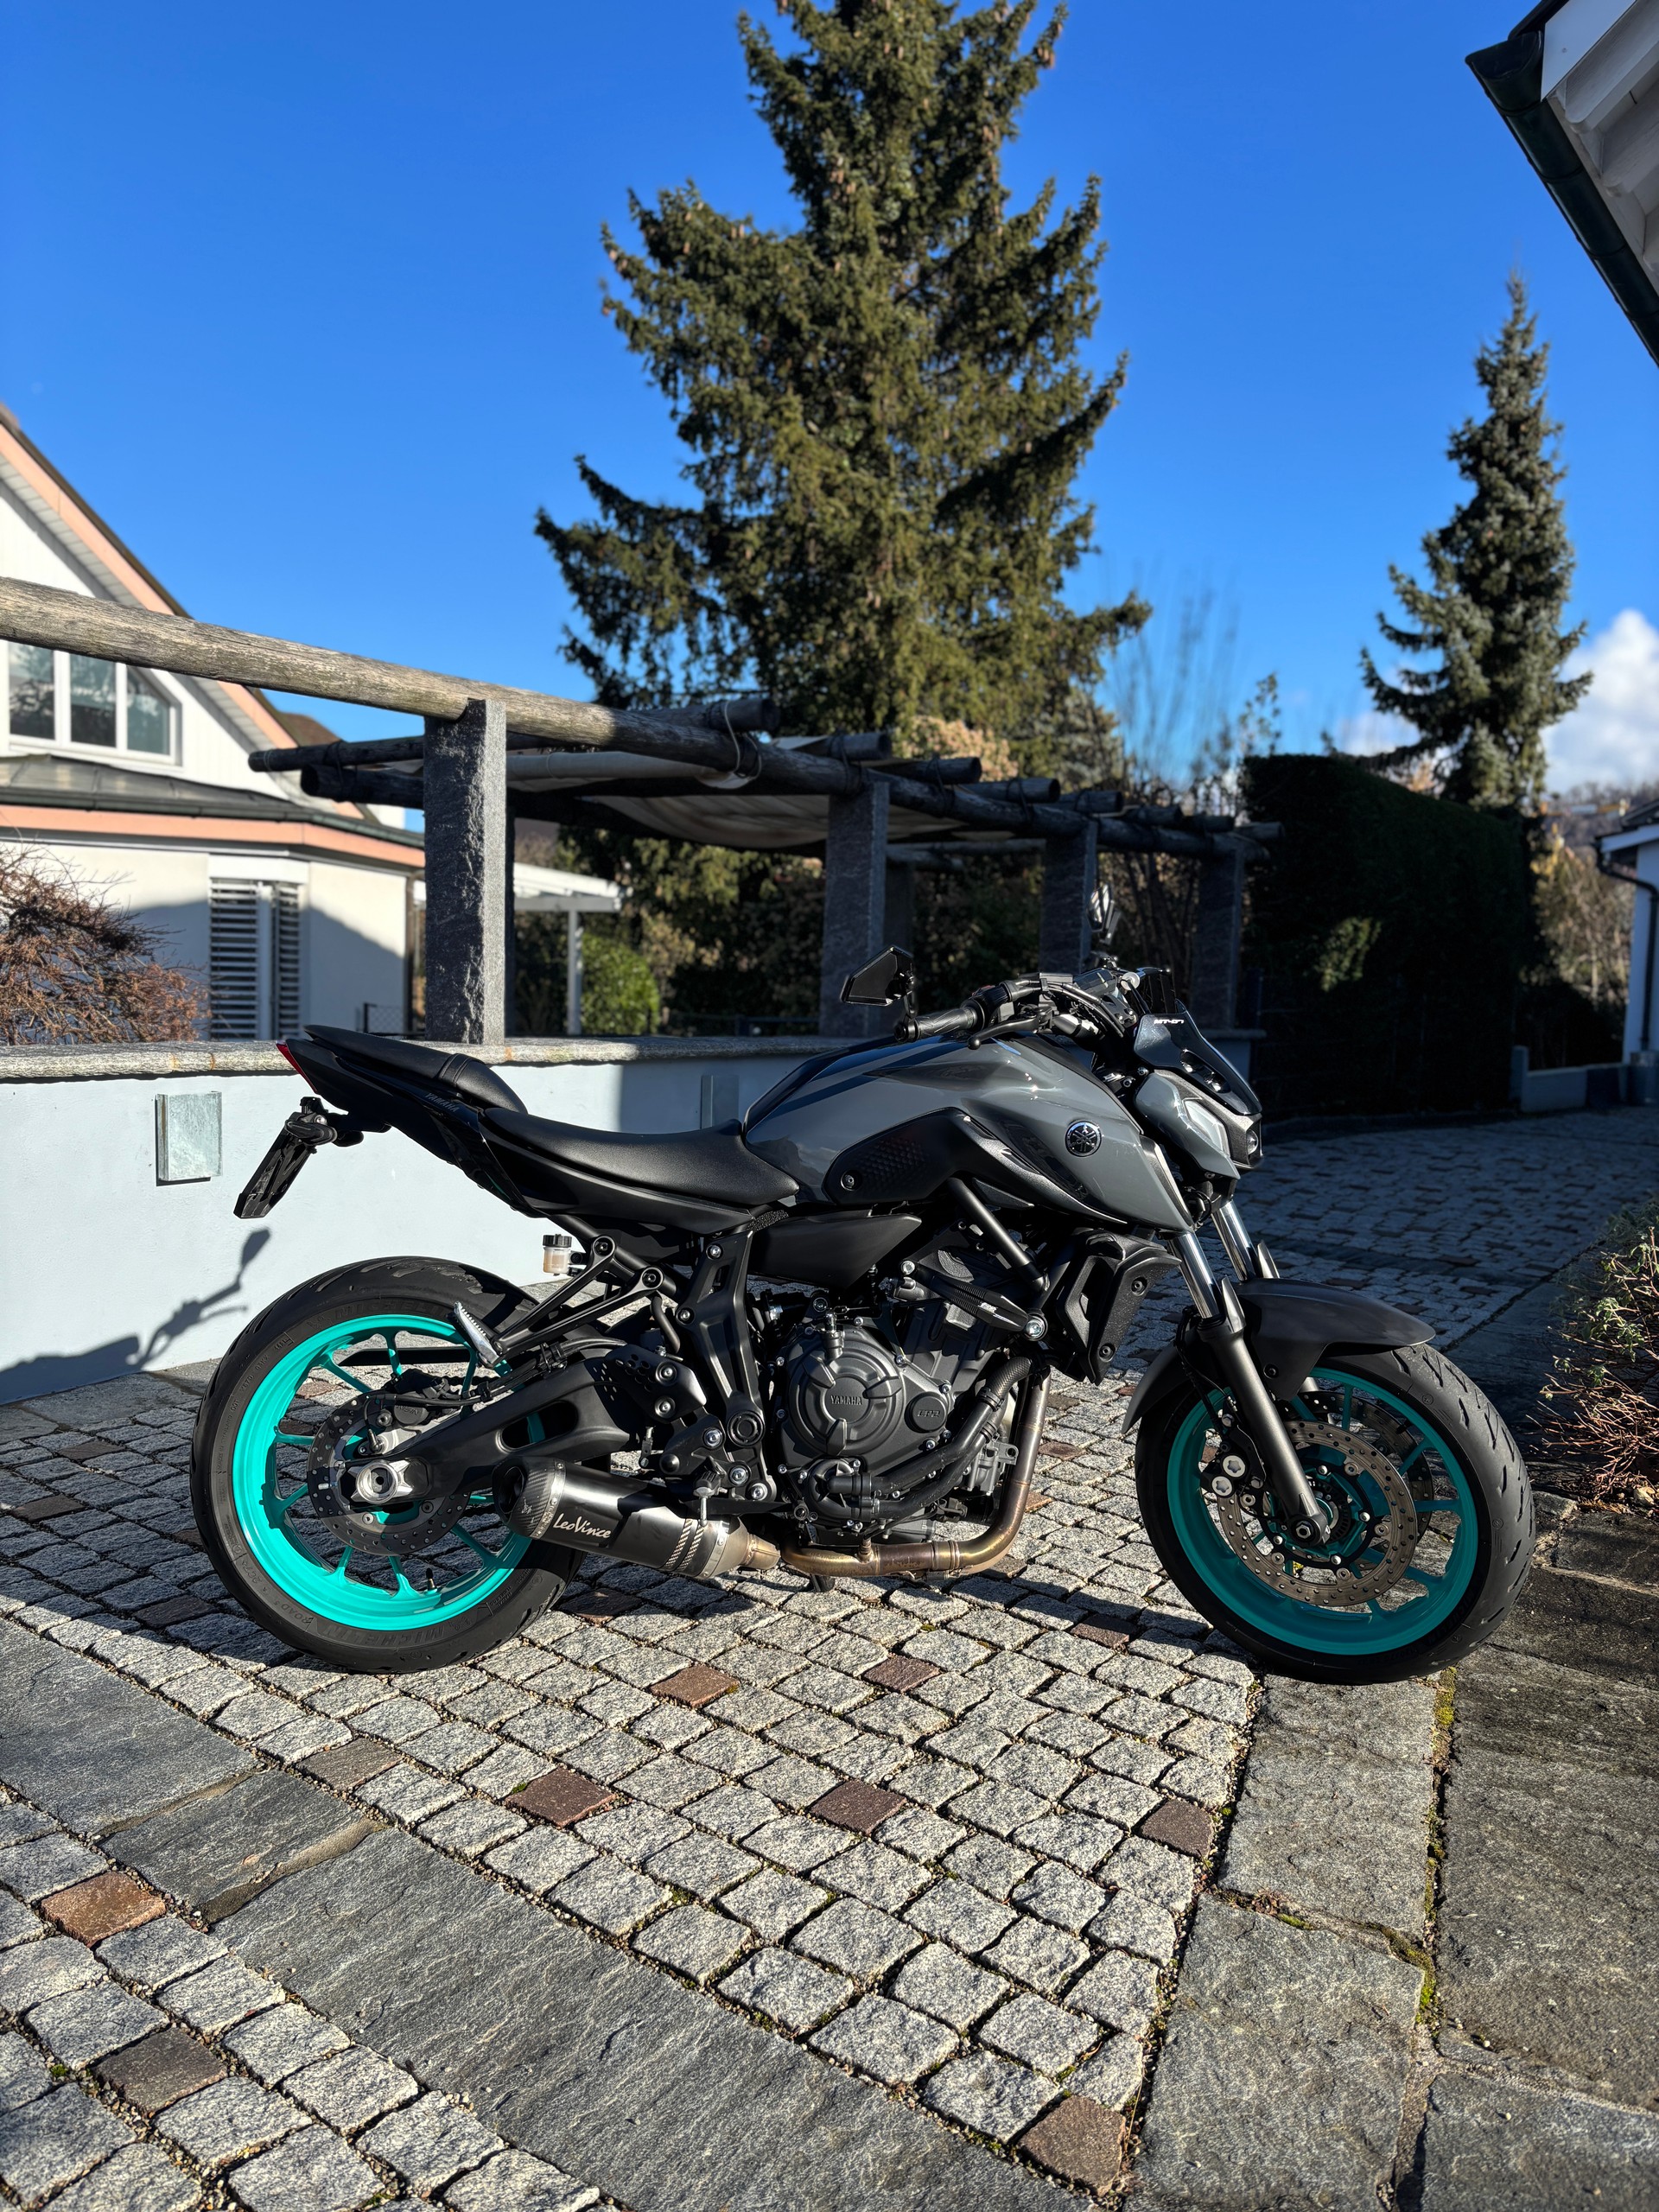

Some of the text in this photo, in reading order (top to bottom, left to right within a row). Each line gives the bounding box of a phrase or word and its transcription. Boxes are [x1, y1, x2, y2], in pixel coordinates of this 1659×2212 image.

[425, 1093, 460, 1112] YAMAHA
[831, 1396, 862, 1406] YAMAHA
[553, 1515, 612, 1539] LeoVince
[279, 1601, 310, 1625] ROAD
[321, 1622, 448, 1647] MICHELIN
